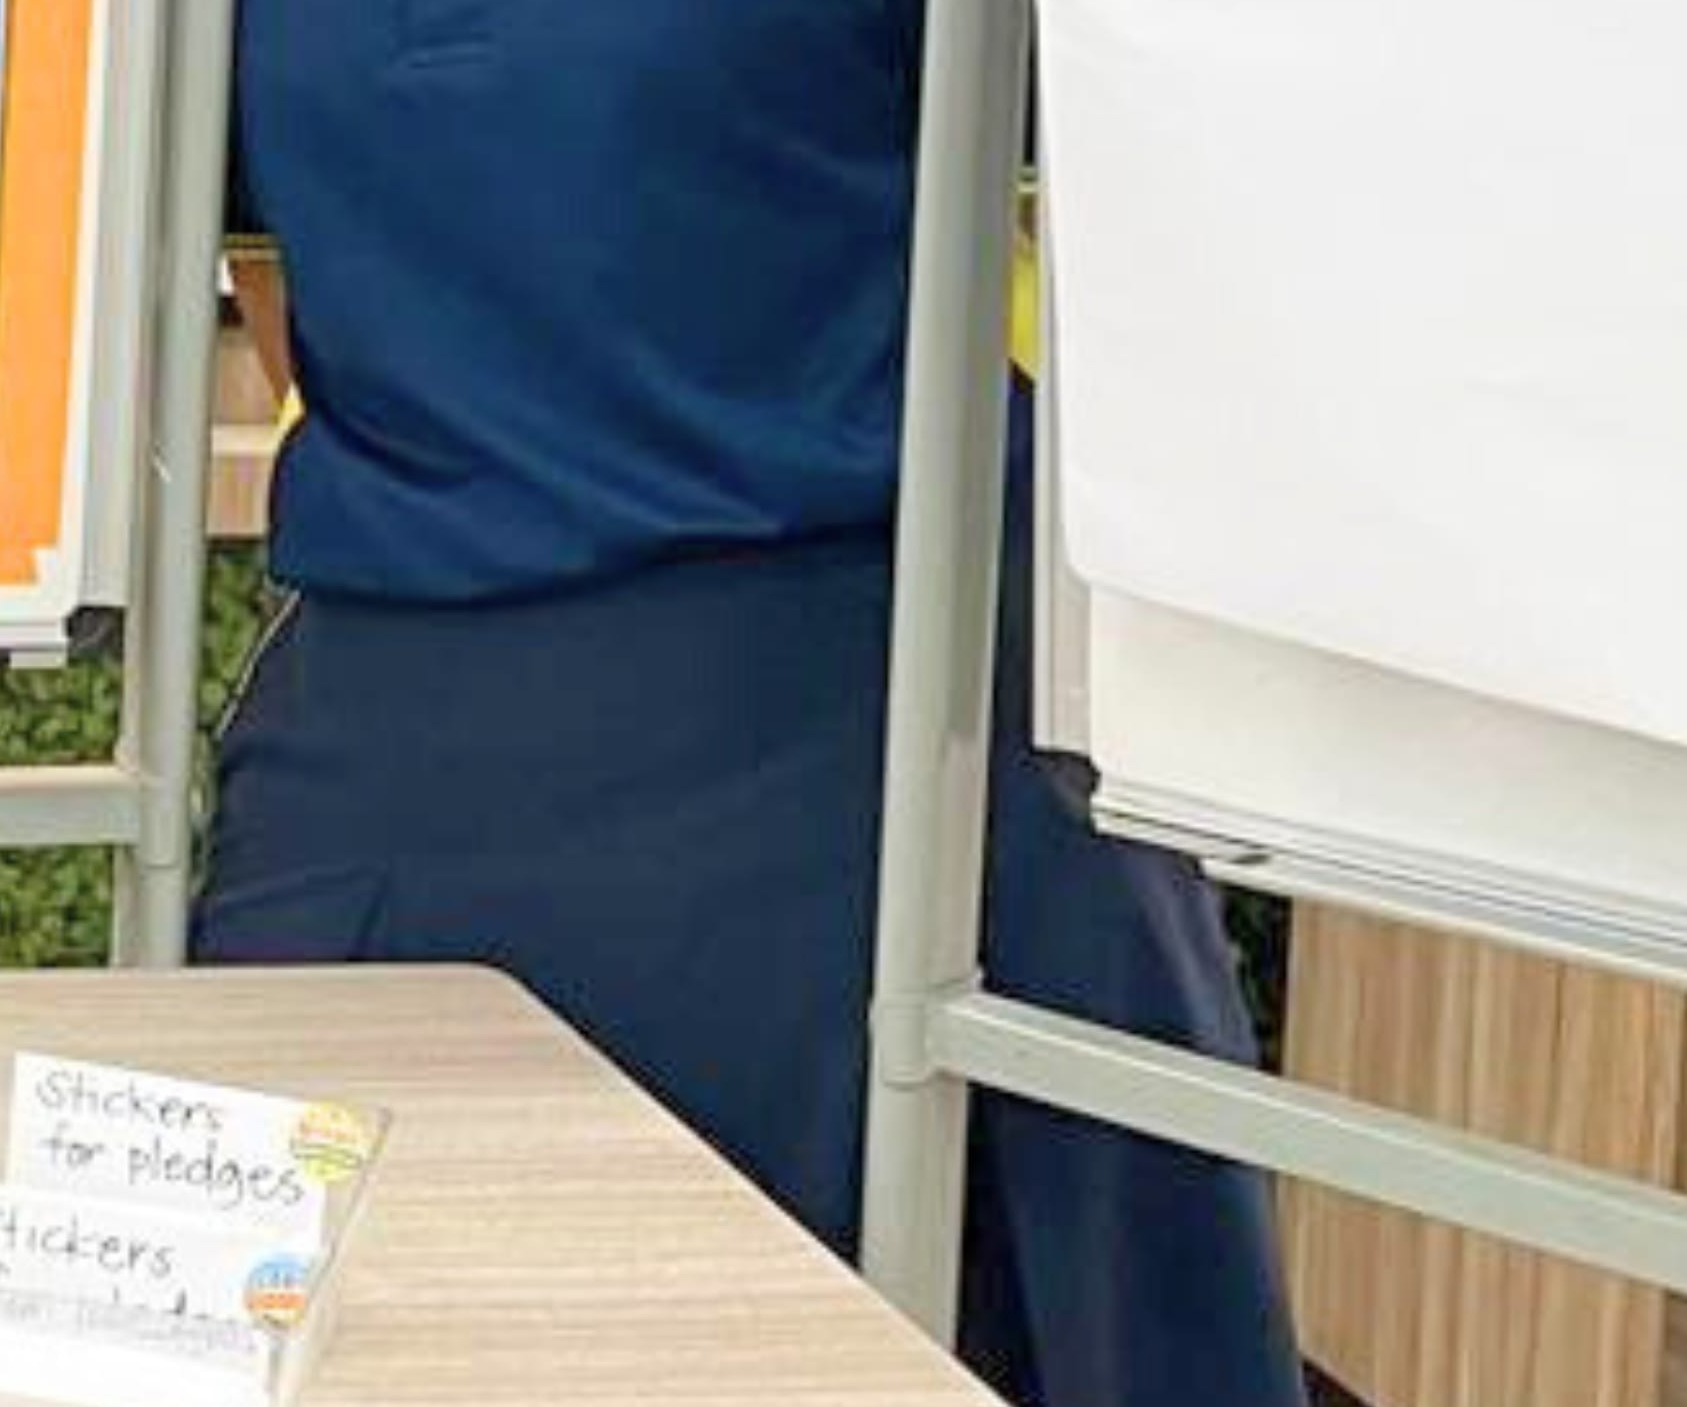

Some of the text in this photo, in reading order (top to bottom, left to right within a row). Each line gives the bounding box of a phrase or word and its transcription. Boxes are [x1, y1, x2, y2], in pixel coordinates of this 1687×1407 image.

[36, 1069, 221, 1134] Stickers
[42, 1124, 305, 1208] for pledges
